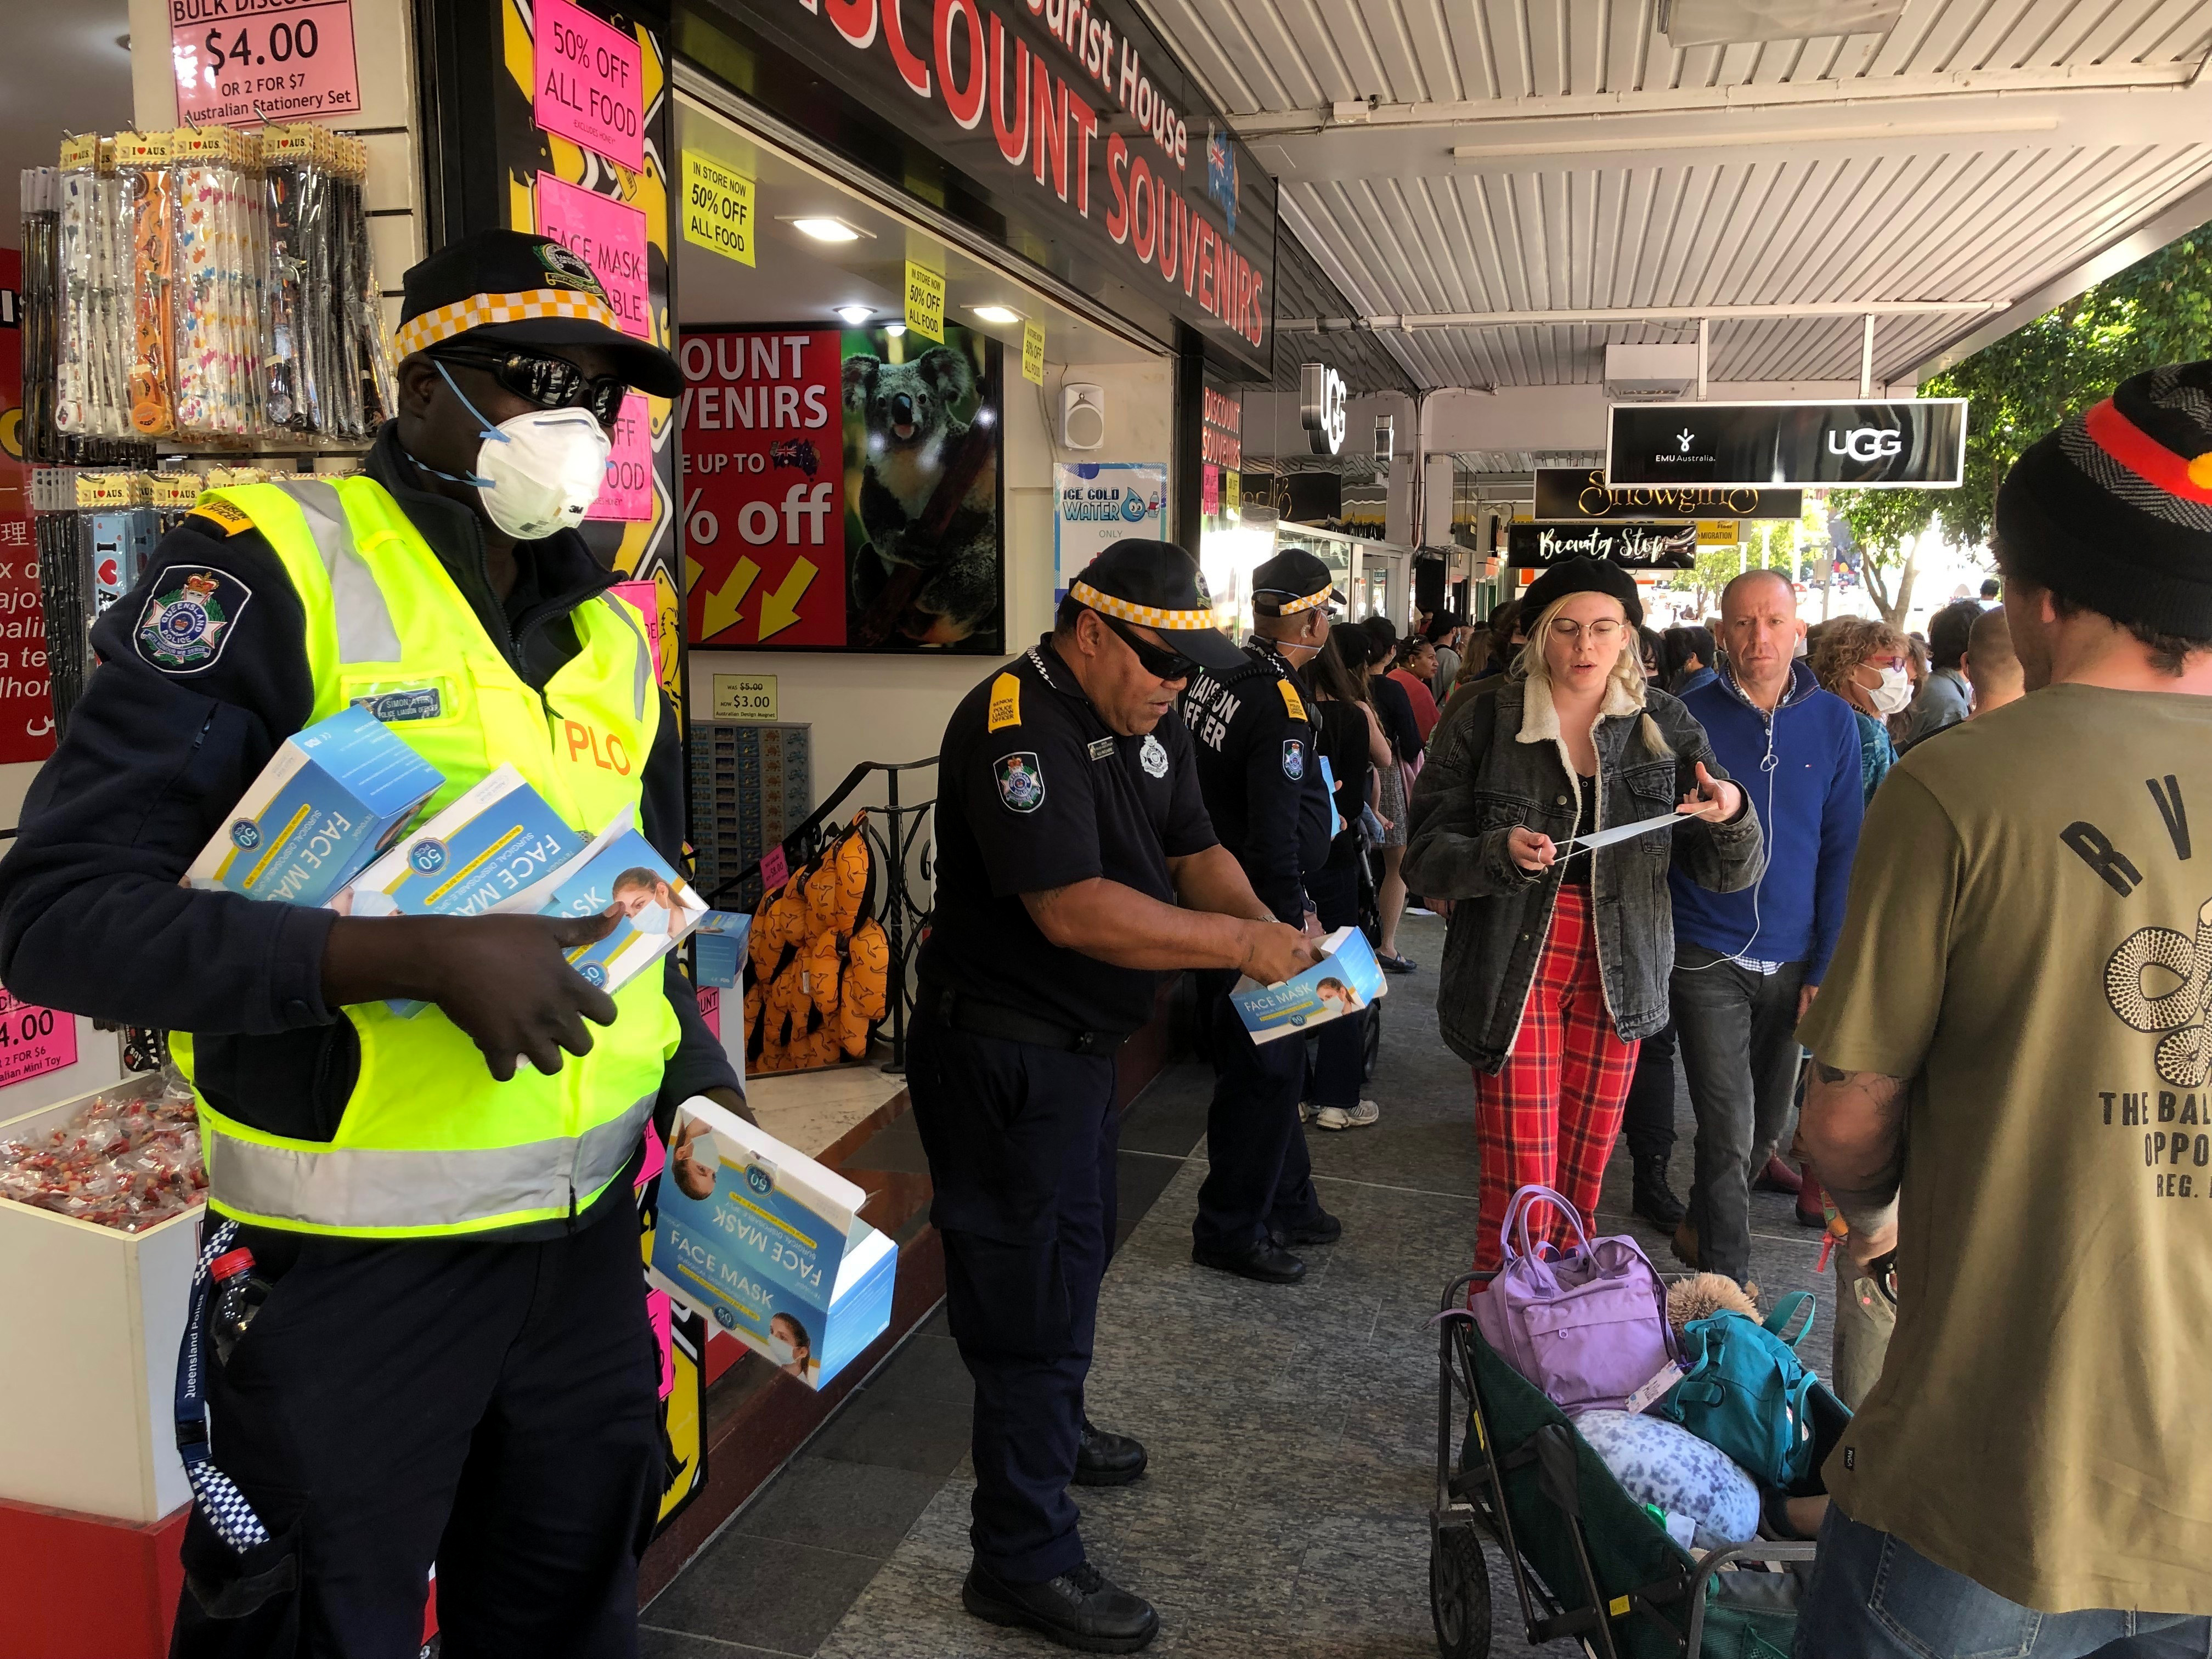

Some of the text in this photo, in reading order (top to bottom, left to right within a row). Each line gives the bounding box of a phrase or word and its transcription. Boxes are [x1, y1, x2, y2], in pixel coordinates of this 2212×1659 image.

[205, 19, 319, 76] $4.00
[553, 20, 629, 89] 50% OFF
[222, 73, 306, 97] OR 2 FOR $7
[184, 90, 352, 123] Australian Stationery Set
[544, 67, 637, 137] ALL FOOD
[1118, 36, 1188, 171] House
[693, 161, 746, 197] IN STORE NOW
[691, 183, 747, 225] 50% OFF
[691, 215, 744, 252] ALL FOOD
[1107, 132, 1263, 348] SOUVENIRS
[597, 242, 641, 281] MASK
[911, 268, 941, 291] IN STORE NOW
[910, 284, 940, 313] 50% OFF
[909, 308, 938, 333] ALL FOOD
[1032, 363, 1040, 377] FOOD
[1204, 386, 1240, 434] DISCOUNT
[1202, 426, 1241, 472] SOUVENIRS
[1829, 427, 1902, 461] UGG
[606, 460, 645, 490] OOD
[698, 454, 727, 473] UP
[732, 454, 764, 473] TO
[1063, 487, 1119, 500] ICE COLD
[738, 482, 833, 545] off
[1063, 501, 1120, 521] WATER
[1540, 527, 1662, 563] Beauty Stop
[161, 603, 205, 633] QUEENSLAND
[156, 640, 176, 654] HONOUR
[161, 629, 192, 644] POLICE
[733, 695, 770, 708] $3.00
[740, 682, 763, 691] $5.00
[386, 698, 409, 708] SIMON
[1183, 699, 1226, 753] OFFER
[564, 719, 631, 777] PLO
[239, 827, 257, 846] 50
[293, 810, 322, 842] SURGICAL
[267, 811, 352, 901] FACE MA
[414, 844, 431, 858] PCS
[419, 849, 442, 870] 50
[496, 832, 535, 863] SURGICAL
[449, 834, 561, 916] FACE MA
[1244, 996, 1276, 1012] FACE
[1276, 982, 1312, 1003] MASK
[5, 1046, 46, 1066] 2 FOR $6
[24, 1060, 42, 1074] Mini
[45, 1056, 61, 1067] Toy
[2098, 1091, 2149, 1126] THE
[750, 1173, 768, 1192] 50
[2157, 1173, 2198, 1198] REG.
[713, 1205, 768, 1252] MASK
[671, 1229, 716, 1272] FACE
[721, 1263, 774, 1309] MASK
[771, 1242, 822, 1286] FACE
[184, 1294, 204, 1397] Queensland Police
